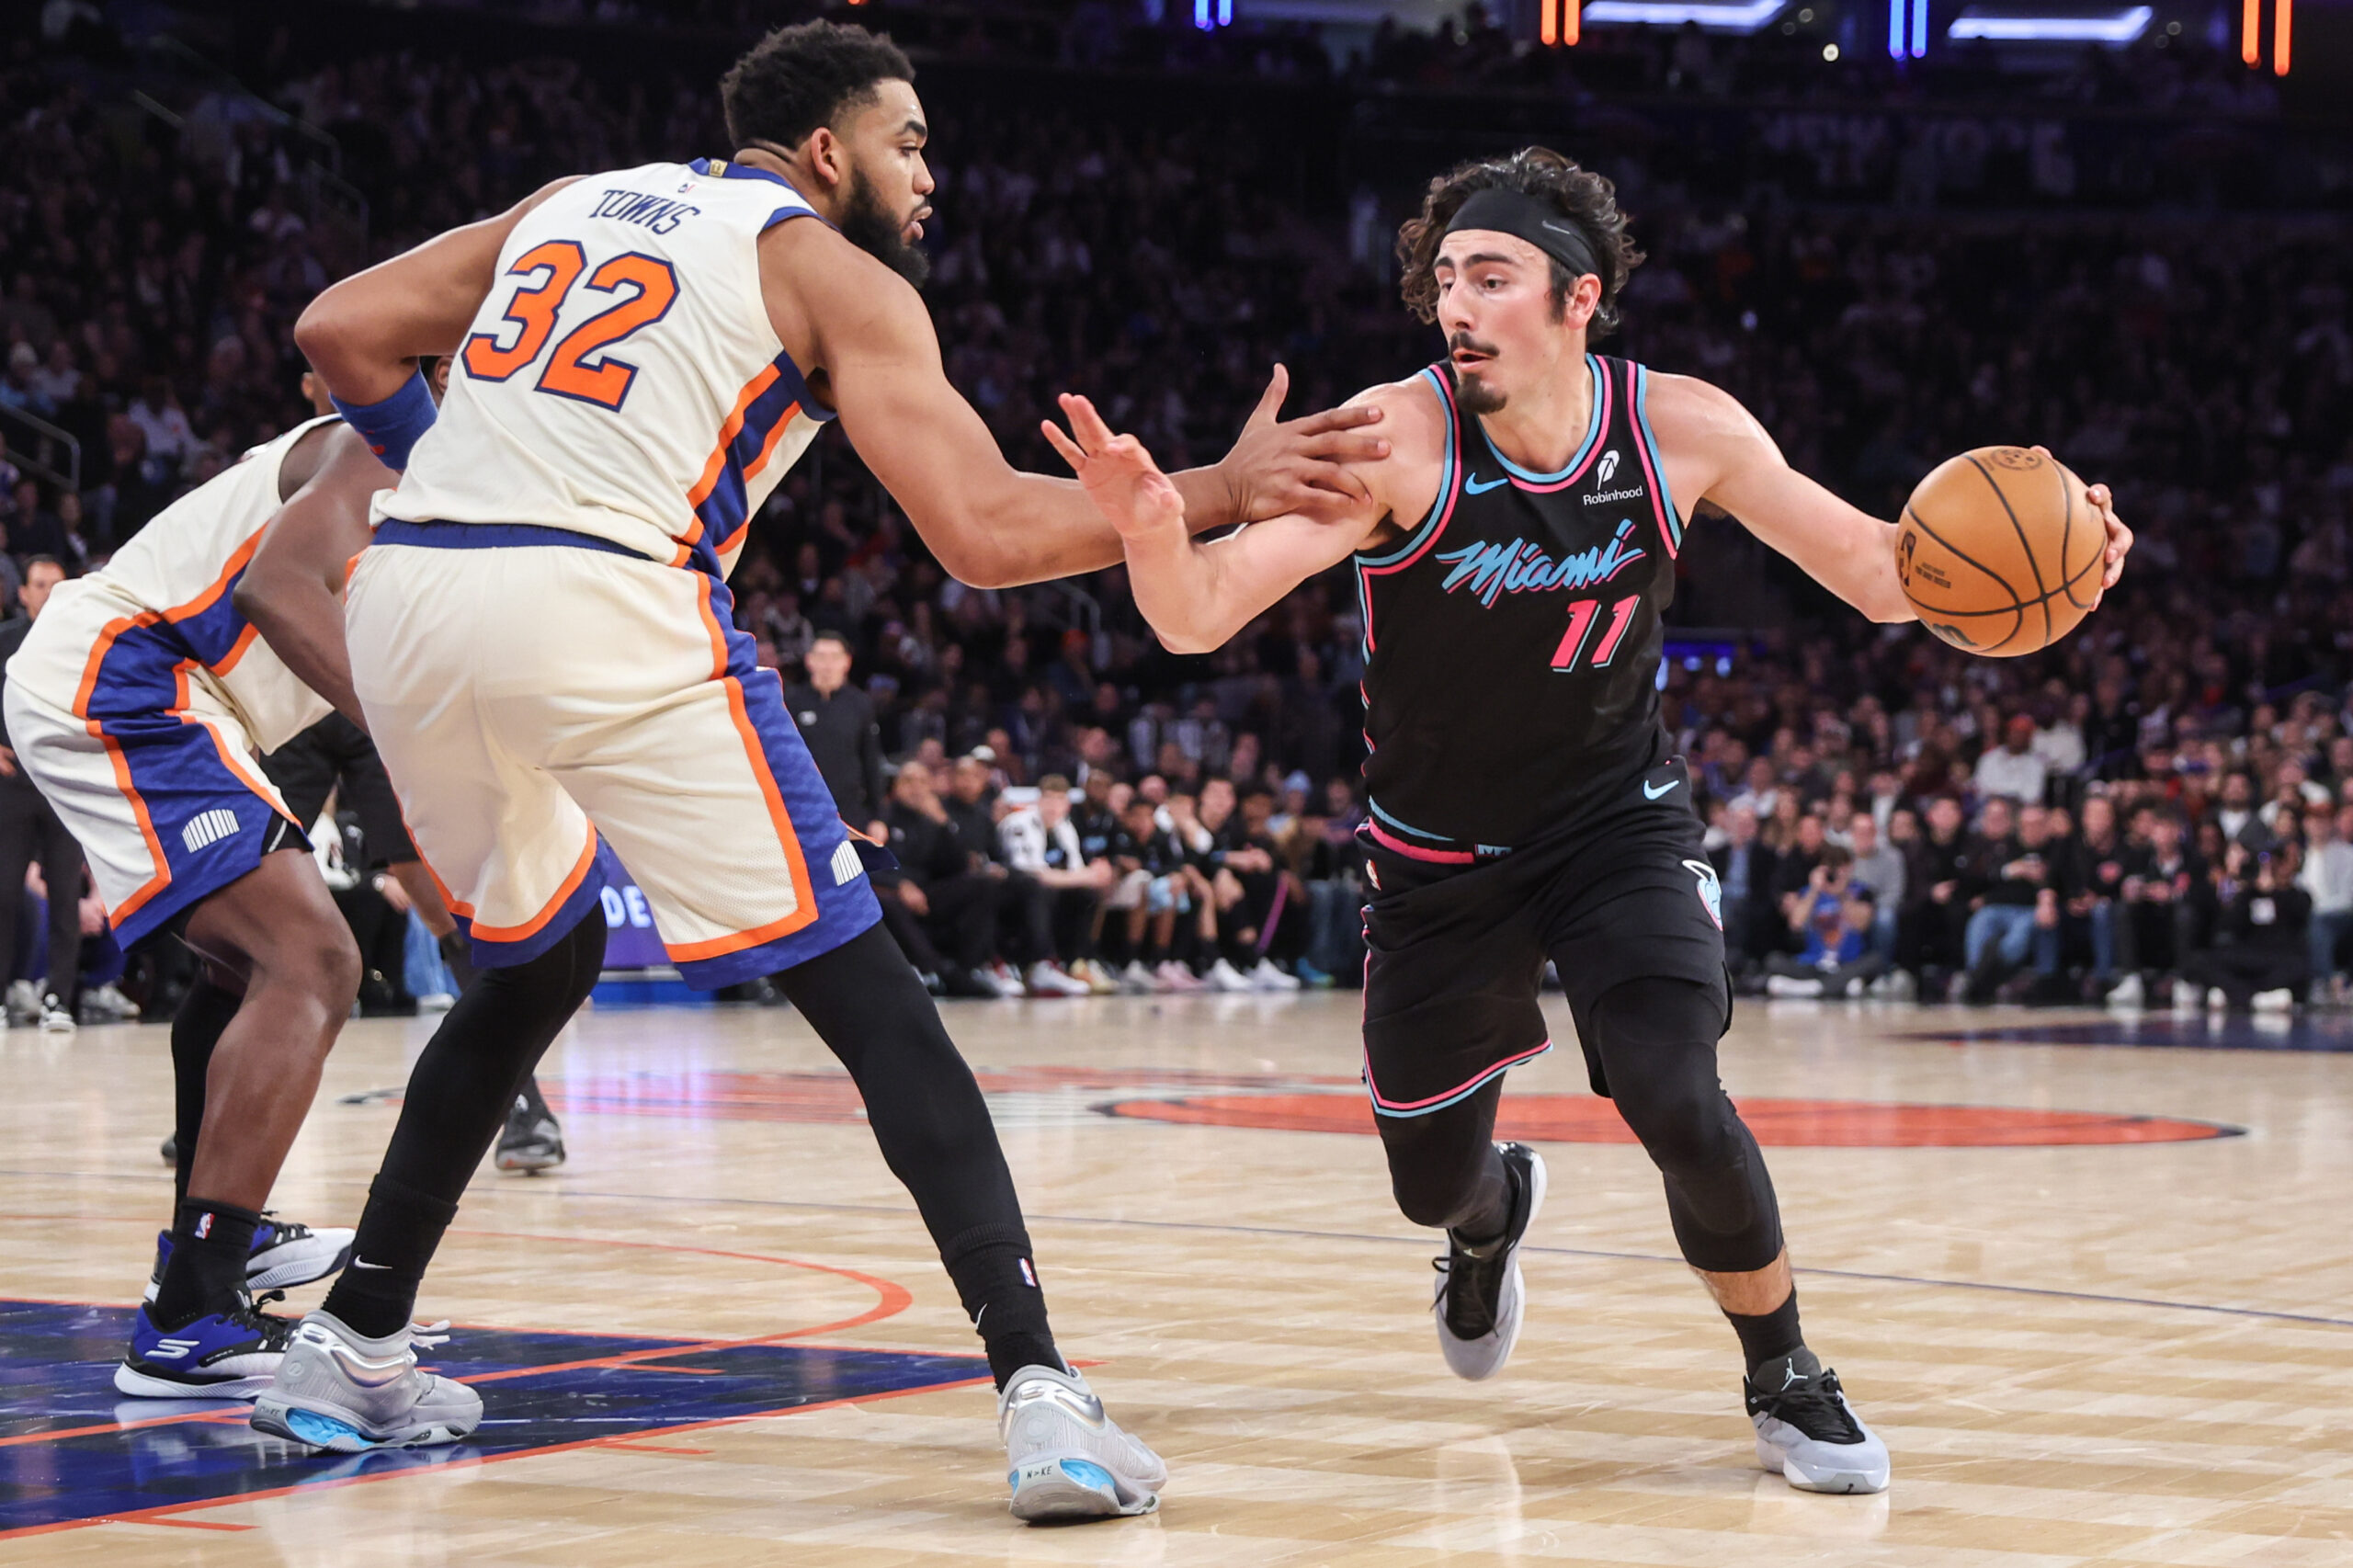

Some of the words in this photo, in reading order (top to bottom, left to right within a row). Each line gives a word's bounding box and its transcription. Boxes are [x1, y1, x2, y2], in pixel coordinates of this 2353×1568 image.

[588, 189, 700, 235] TOWNS
[461, 240, 680, 413] 32
[1583, 486, 1643, 506] Robinhood
[1435, 518, 1646, 609] Miami
[1550, 594, 1641, 673] 11
